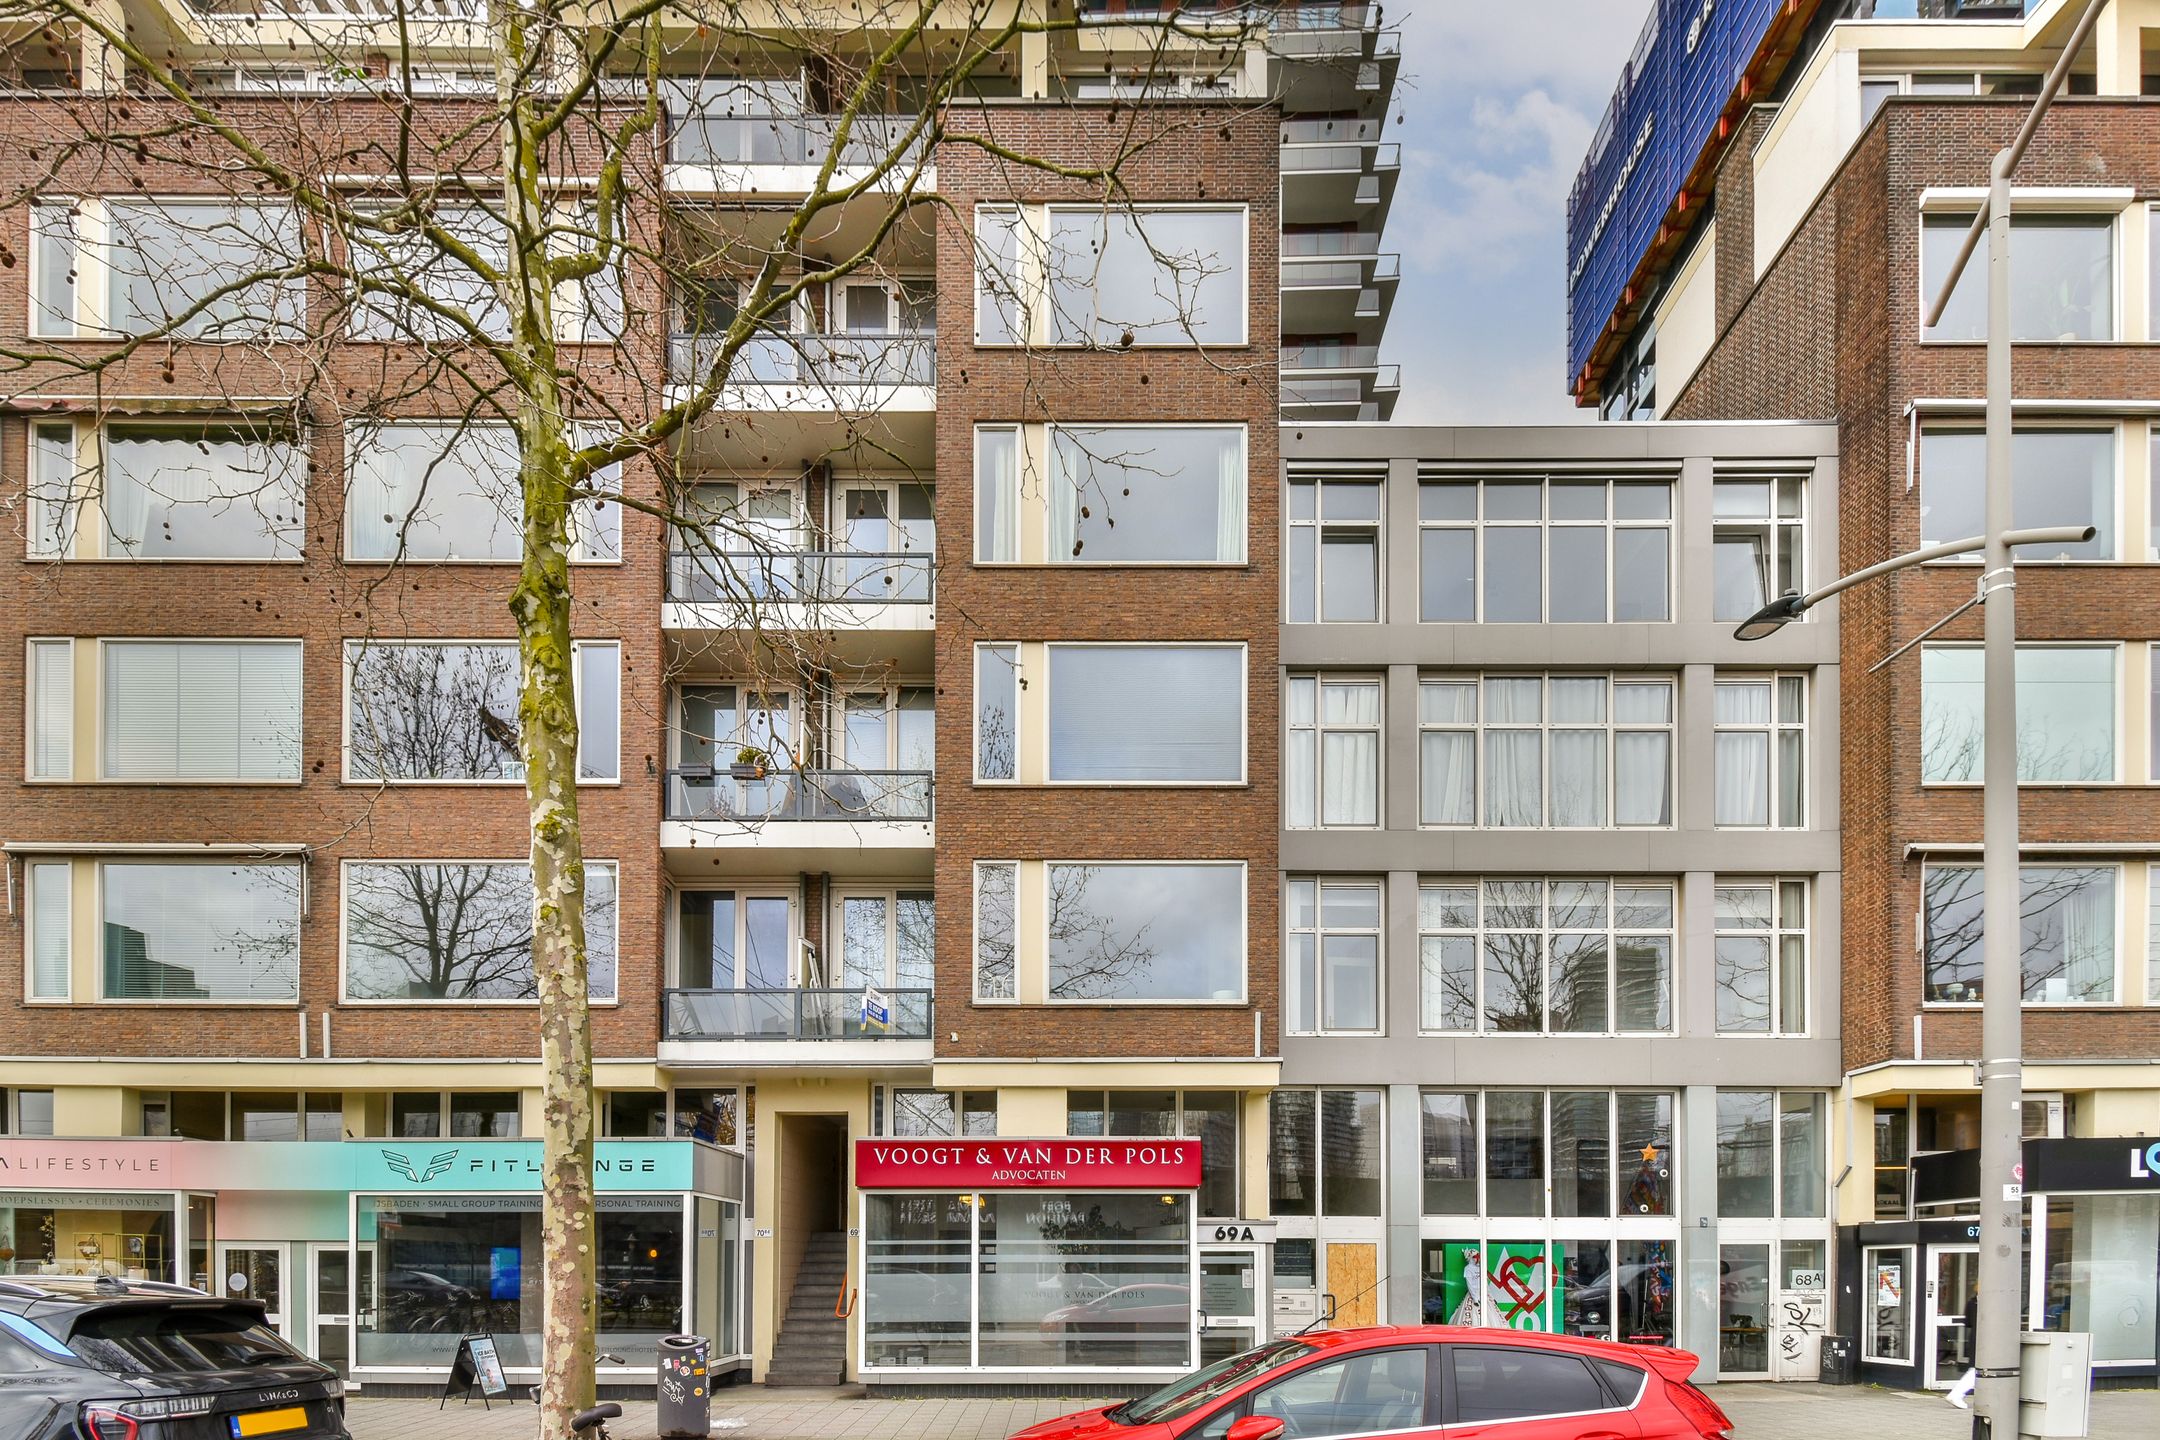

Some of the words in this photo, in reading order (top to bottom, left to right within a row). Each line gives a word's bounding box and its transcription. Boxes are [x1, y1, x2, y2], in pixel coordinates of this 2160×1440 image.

[1569, 111, 1655, 291] POWERHOUSE
[874, 1147, 964, 1165] VOOGT
[975, 1148, 992, 1165] &
[1003, 1147, 1052, 1165] VAN
[1065, 1147, 1114, 1165] DER
[1126, 1147, 1184, 1165] POLS
[19, 1157, 160, 1171] LIFESTYLE
[470, 1159, 655, 1172] FITLNGE
[991, 1169, 1067, 1180] ADVOCATEN
[86, 1197, 160, 1207] CEREMONIES
[428, 1200, 459, 1208] SMALL
[462, 1200, 496, 1208] GROUP
[499, 1200, 543, 1208] TRAINING
[595, 1200, 633, 1208] RSONAL
[636, 1200, 681, 1208] TRAINING
[1214, 1226, 1255, 1241] 69A
[1074, 1291, 1095, 1299] VAN
[1121, 1291, 1146, 1299] POLS
